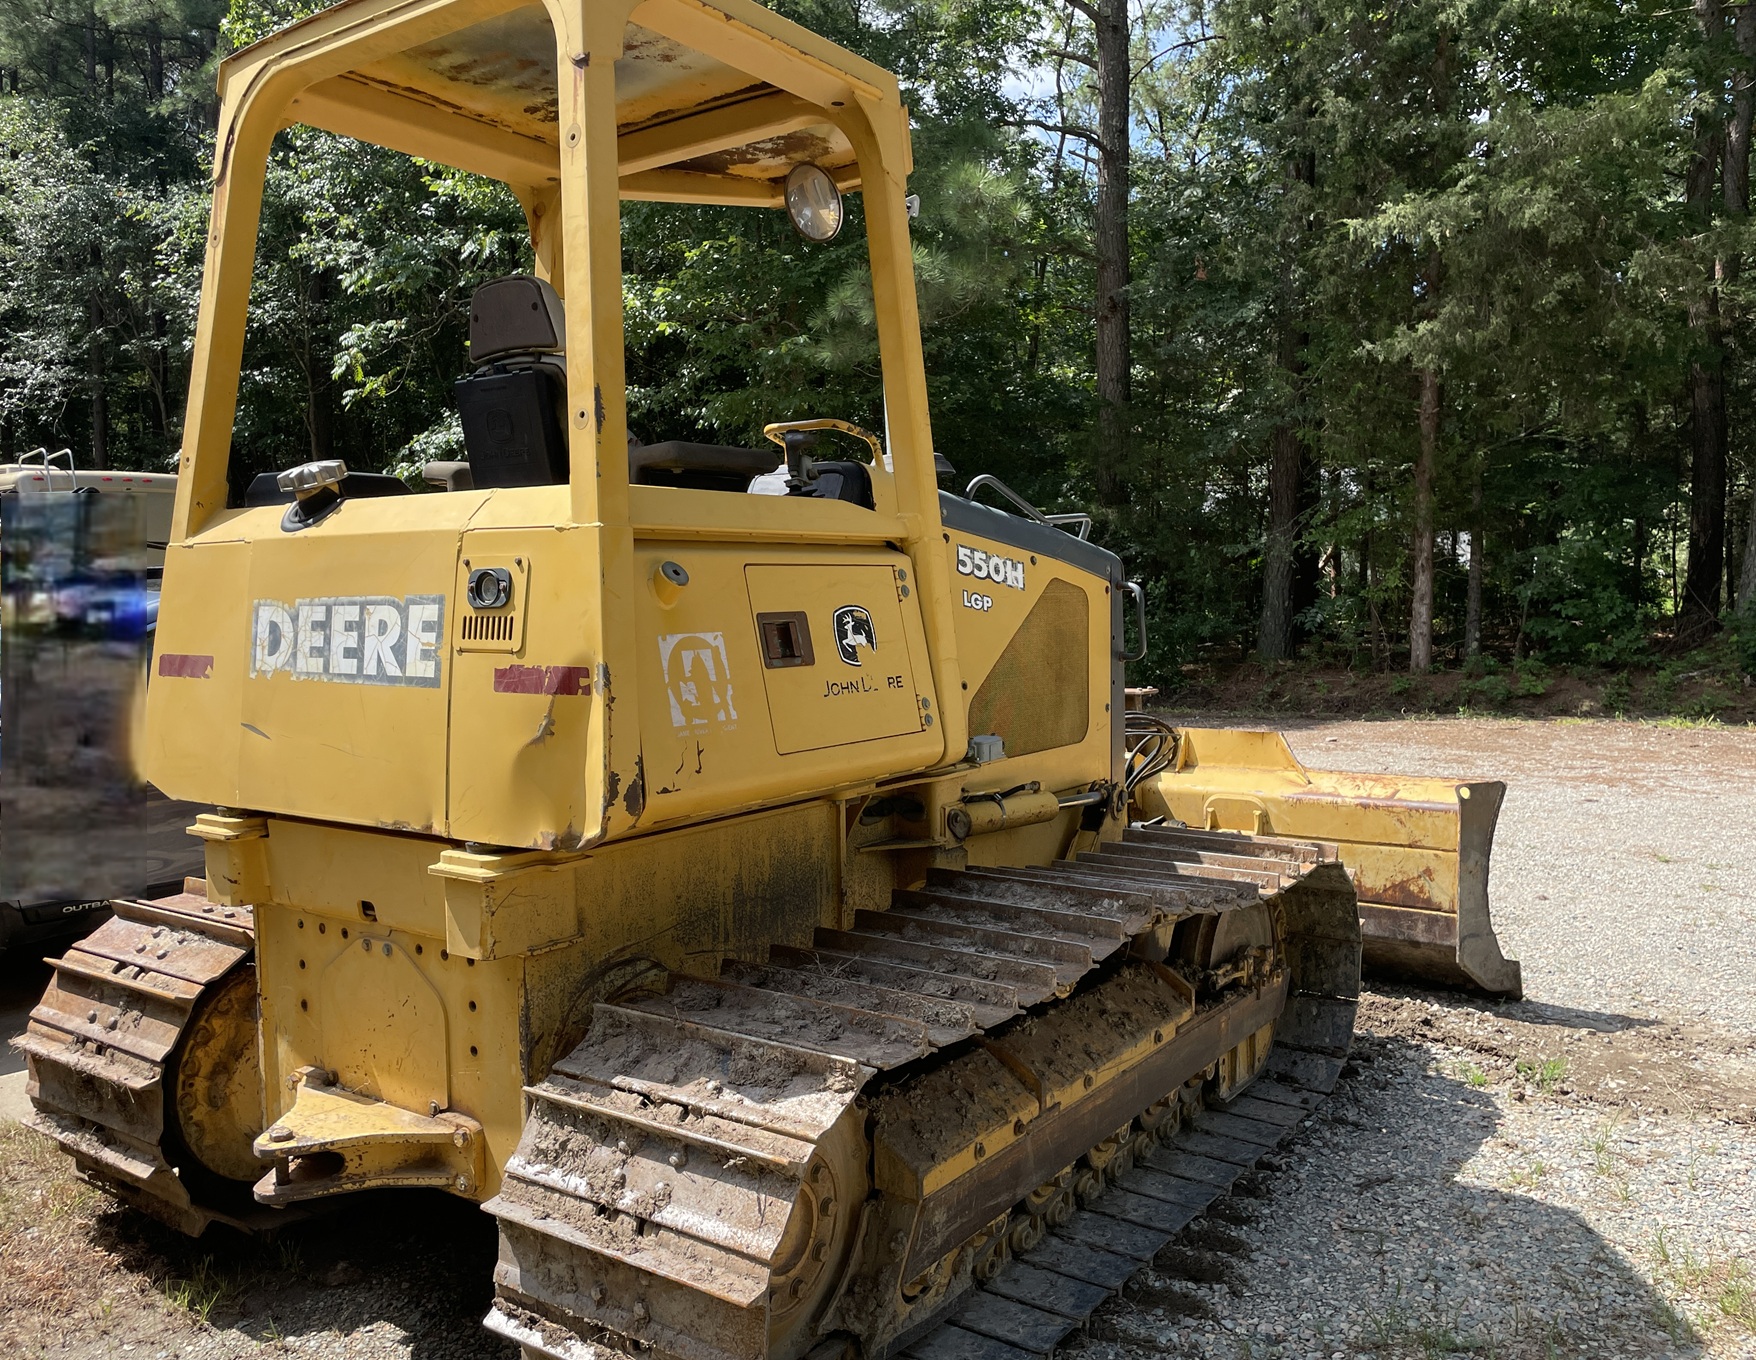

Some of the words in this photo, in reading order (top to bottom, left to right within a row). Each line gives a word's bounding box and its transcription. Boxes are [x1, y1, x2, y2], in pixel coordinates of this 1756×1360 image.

[957, 544, 1025, 591] 550H
[963, 590, 993, 612] LGP
[255, 603, 439, 678] DEERE
[824, 680, 860, 698] JOHN
[861, 675, 904, 693] DRE
[62, 900, 110, 913] OUTBA
